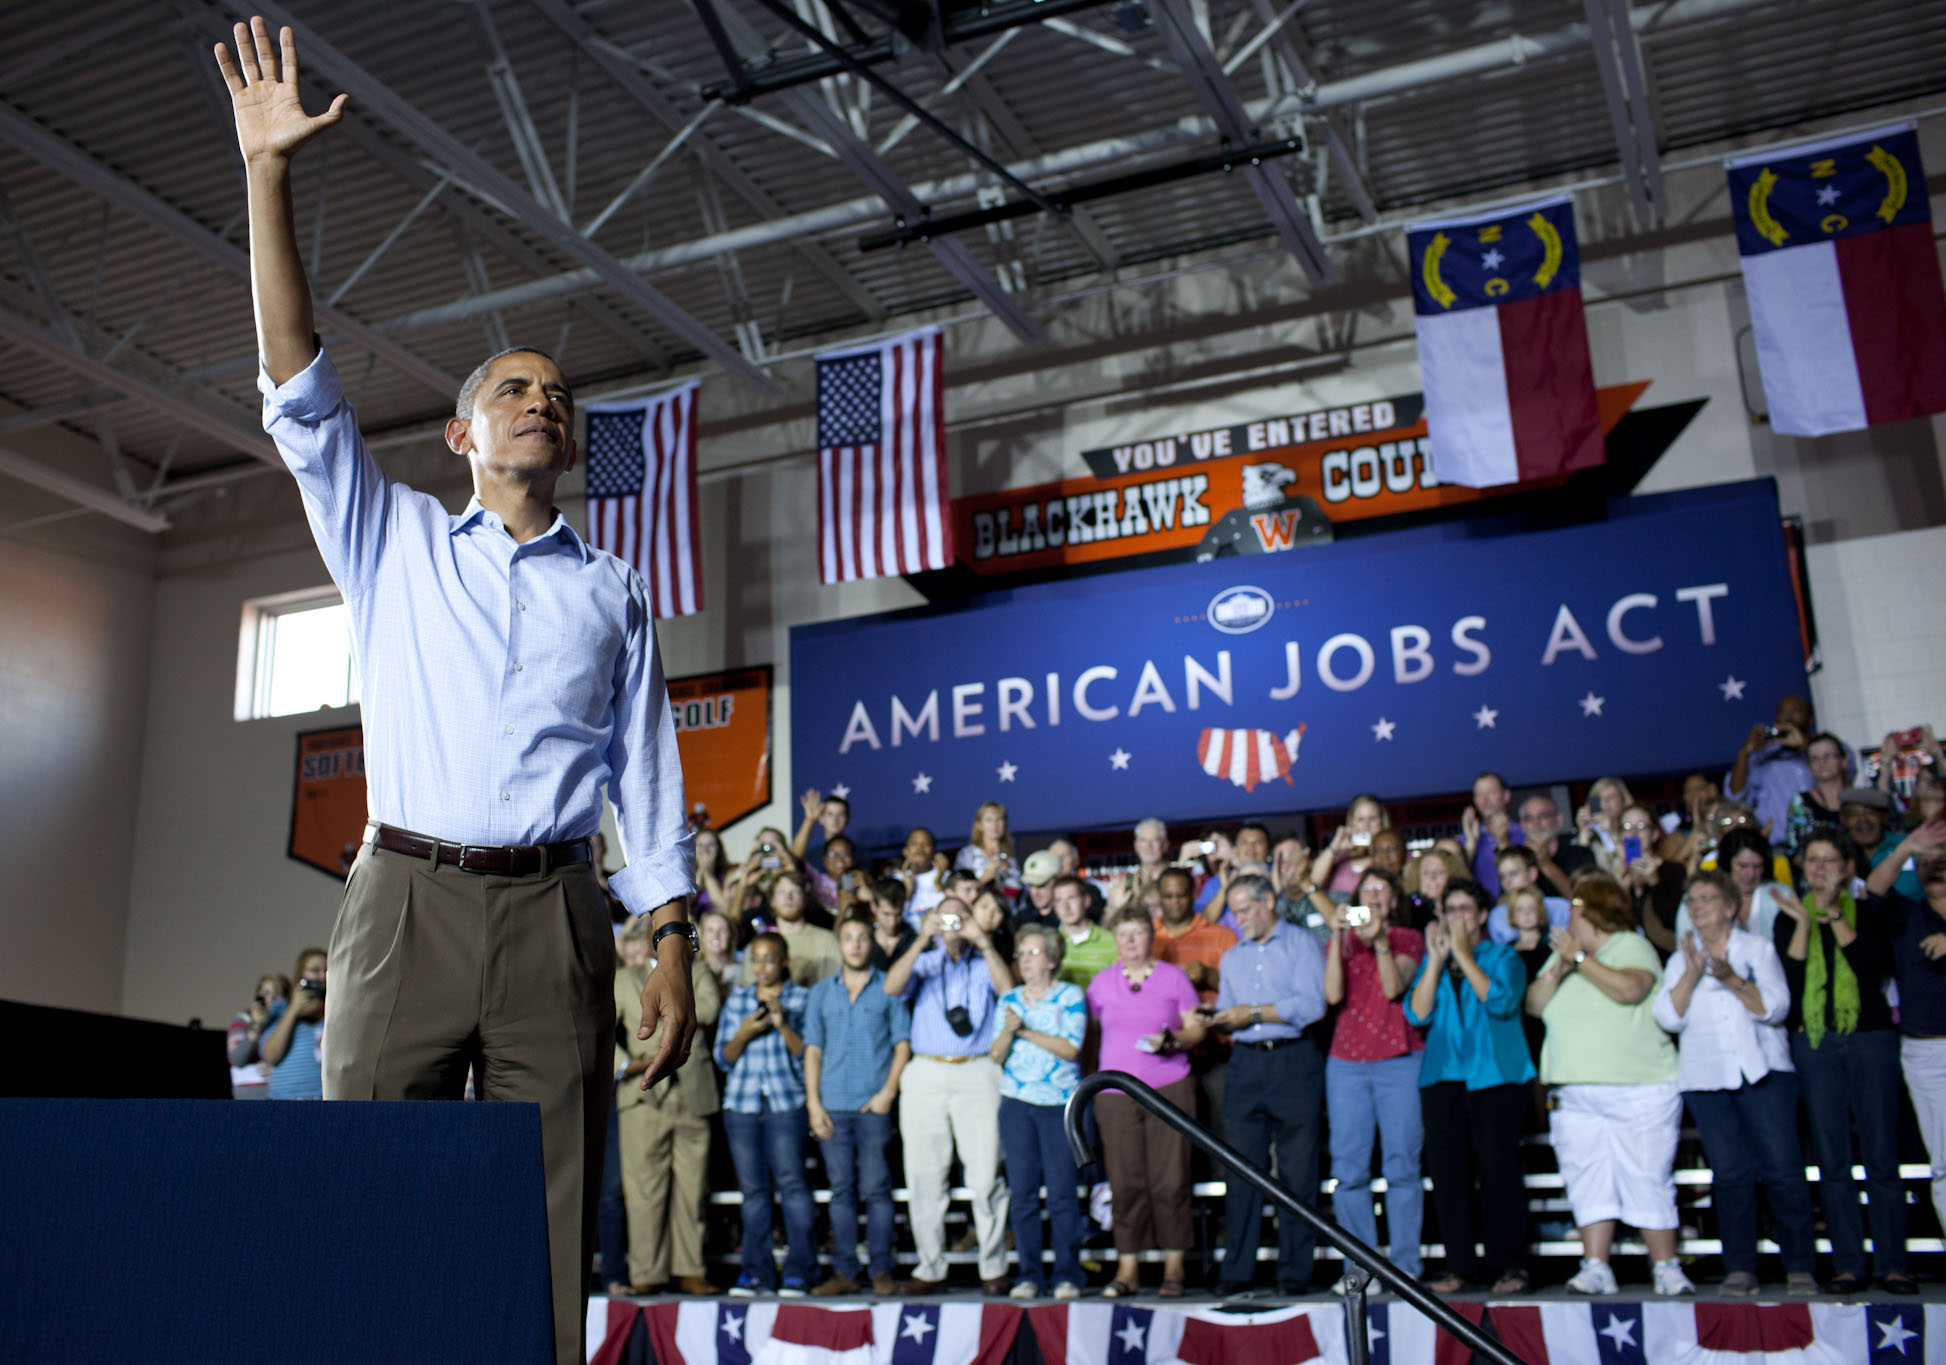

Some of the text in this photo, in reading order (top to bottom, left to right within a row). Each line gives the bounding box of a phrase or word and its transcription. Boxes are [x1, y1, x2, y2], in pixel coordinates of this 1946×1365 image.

[1112, 401, 1396, 474] YOU'VE ENTERED
[973, 473, 1211, 561] BLACKHAWK
[1250, 507, 1303, 554] W
[838, 583, 1729, 754] AMERICAN JOBS ACT
